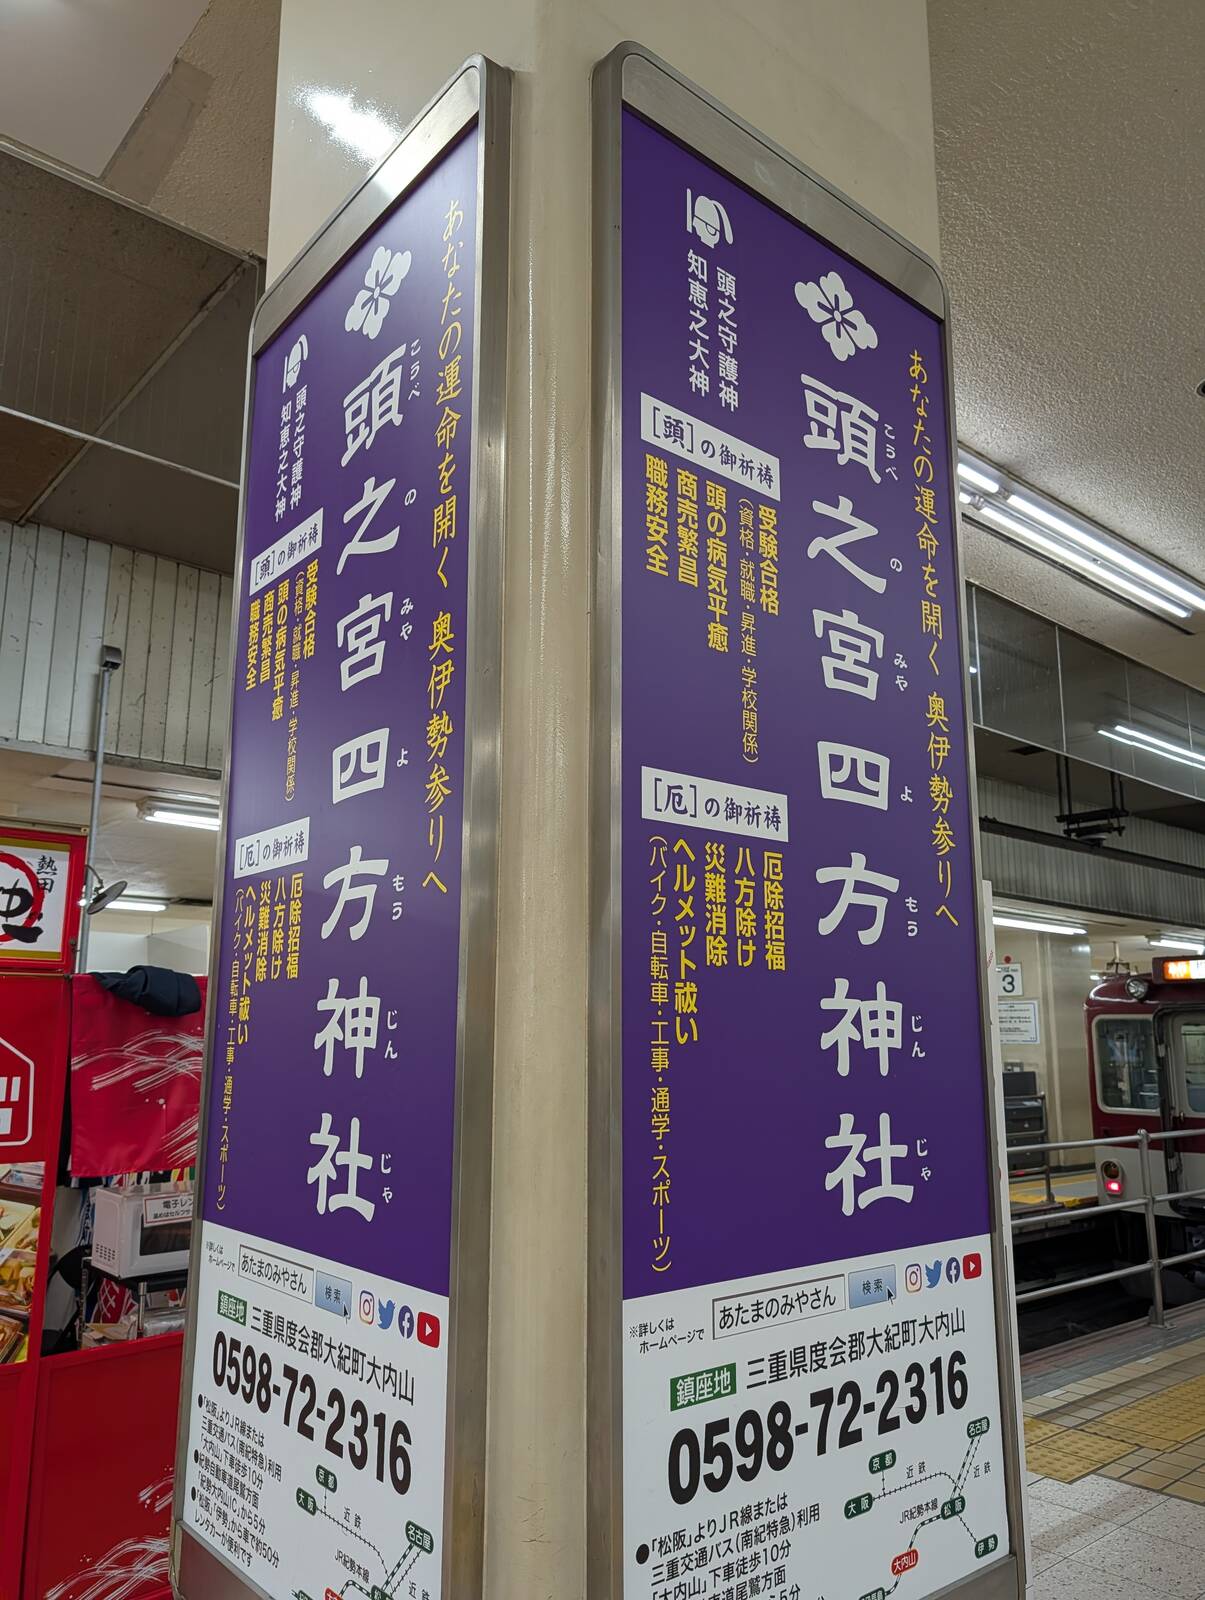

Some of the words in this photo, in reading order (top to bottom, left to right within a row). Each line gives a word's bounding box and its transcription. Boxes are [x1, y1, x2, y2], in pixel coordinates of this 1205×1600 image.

[407, 338, 421, 399] こうべ
[686, 249, 711, 397] 知恵之大神
[716, 266, 739, 412] 頭之守護神
[431, 199, 464, 588] あなたの運命を開く
[274, 400, 292, 522] 知恵之大神
[289, 384, 307, 510] 頭之守護神
[404, 488, 417, 506] の
[884, 423, 898, 481] こうべ
[645, 453, 669, 577] 職務安全
[677, 467, 699, 588] 商売繁昌
[758, 504, 779, 616] 受験合格
[909, 349, 943, 676] あなたの運命を開く
[302, 558, 319, 660] 受験合格
[705, 480, 729, 653] 頭の病気平癒
[890, 557, 903, 573] の
[245, 598, 261, 691] 職務安全
[271, 578, 290, 722] 頭の病気平癒
[400, 598, 414, 641] みや
[894, 653, 908, 692] みや
[306, 343, 407, 1222] 頭之宮四方神社
[396, 748, 409, 767] よ
[421, 610, 457, 894] 奥伊勢参りへ
[800, 372, 914, 1217] 頭之宮四方神社
[900, 786, 913, 803] よ
[925, 691, 959, 926] 奥伊勢参りへ
[255, 879, 272, 982] 災難消除
[270, 876, 287, 980] 八方除け
[286, 872, 304, 980] 厄除招福
[391, 875, 405, 921] もう
[672, 838, 699, 1045] ヘルメット祓い
[704, 841, 728, 968] 災難消除
[734, 846, 757, 968] 八方除け
[762, 850, 787, 972] 厄除招福
[904, 896, 919, 937] もう
[1001, 973, 1016, 993] 3
[384, 1011, 398, 1060] じん
[911, 1014, 926, 1059] じん
[241, 1254, 307, 1294] あたまのみやさん
[324, 1285, 341, 1304] 検索
[718, 1285, 837, 1330] あたまのみやさん
[861, 1278, 884, 1295] 検索
[250, 1305, 415, 1406] 三重県度会郡大紀町大内山
[639, 1328, 705, 1354] ホームページで
[675, 1367, 732, 1406] 鎮座地
[746, 1307, 966, 1390] 三重県度会郡大紀町大内山
[213, 1331, 412, 1495] 0598-72-2316
[668, 1350, 969, 1505] 0598-72-2316
[905, 1461, 926, 1479] 近鉄
[893, 1552, 917, 1574] 大内山
